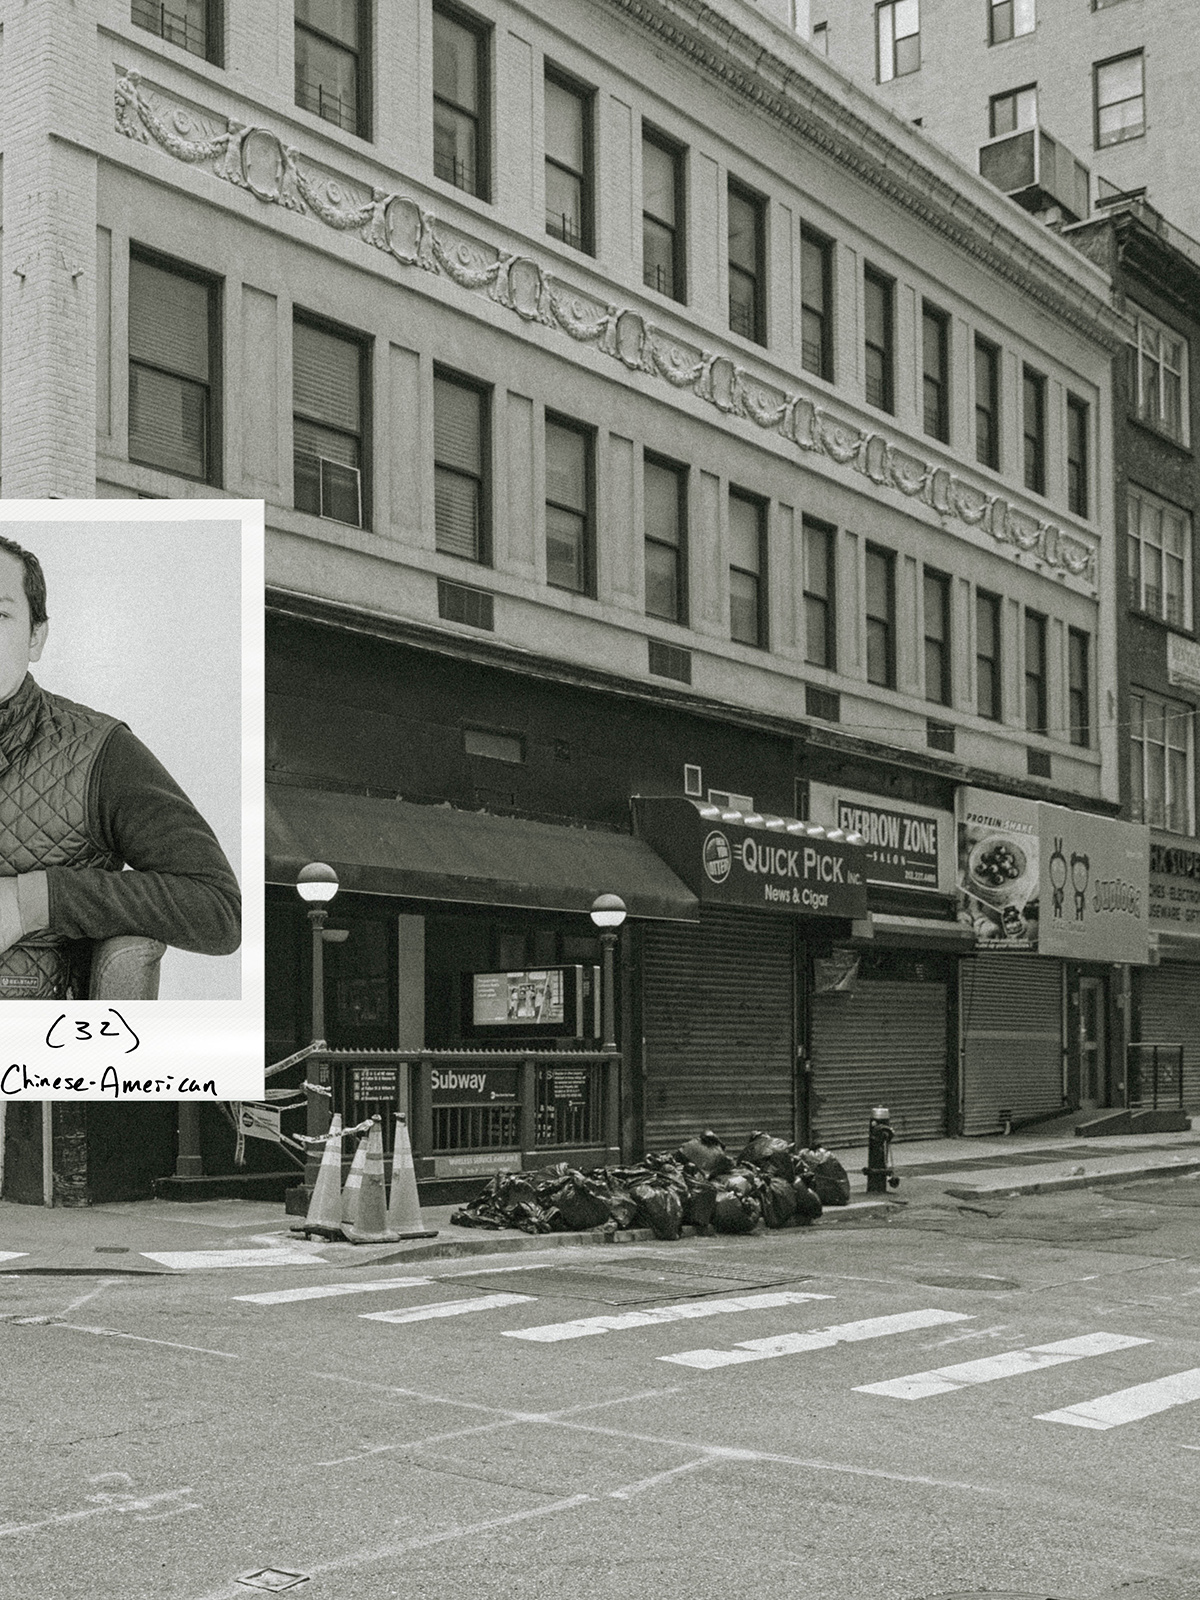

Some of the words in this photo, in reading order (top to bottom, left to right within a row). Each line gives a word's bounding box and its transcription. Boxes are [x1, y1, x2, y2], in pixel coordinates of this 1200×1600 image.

[840, 806, 900, 849] EYEBROW
[903, 820, 936, 855] ZONE
[966, 812, 1001, 828] PROTEIN
[1004, 819, 1034, 834] SHAKE
[742, 837, 799, 879] QUICK
[803, 847, 844, 884] PICK
[873, 851, 906, 866] SALON
[764, 883, 791, 904] News
[792, 886, 800, 904] &
[802, 887, 829, 910] Cigar
[431, 1069, 487, 1093] Subway
